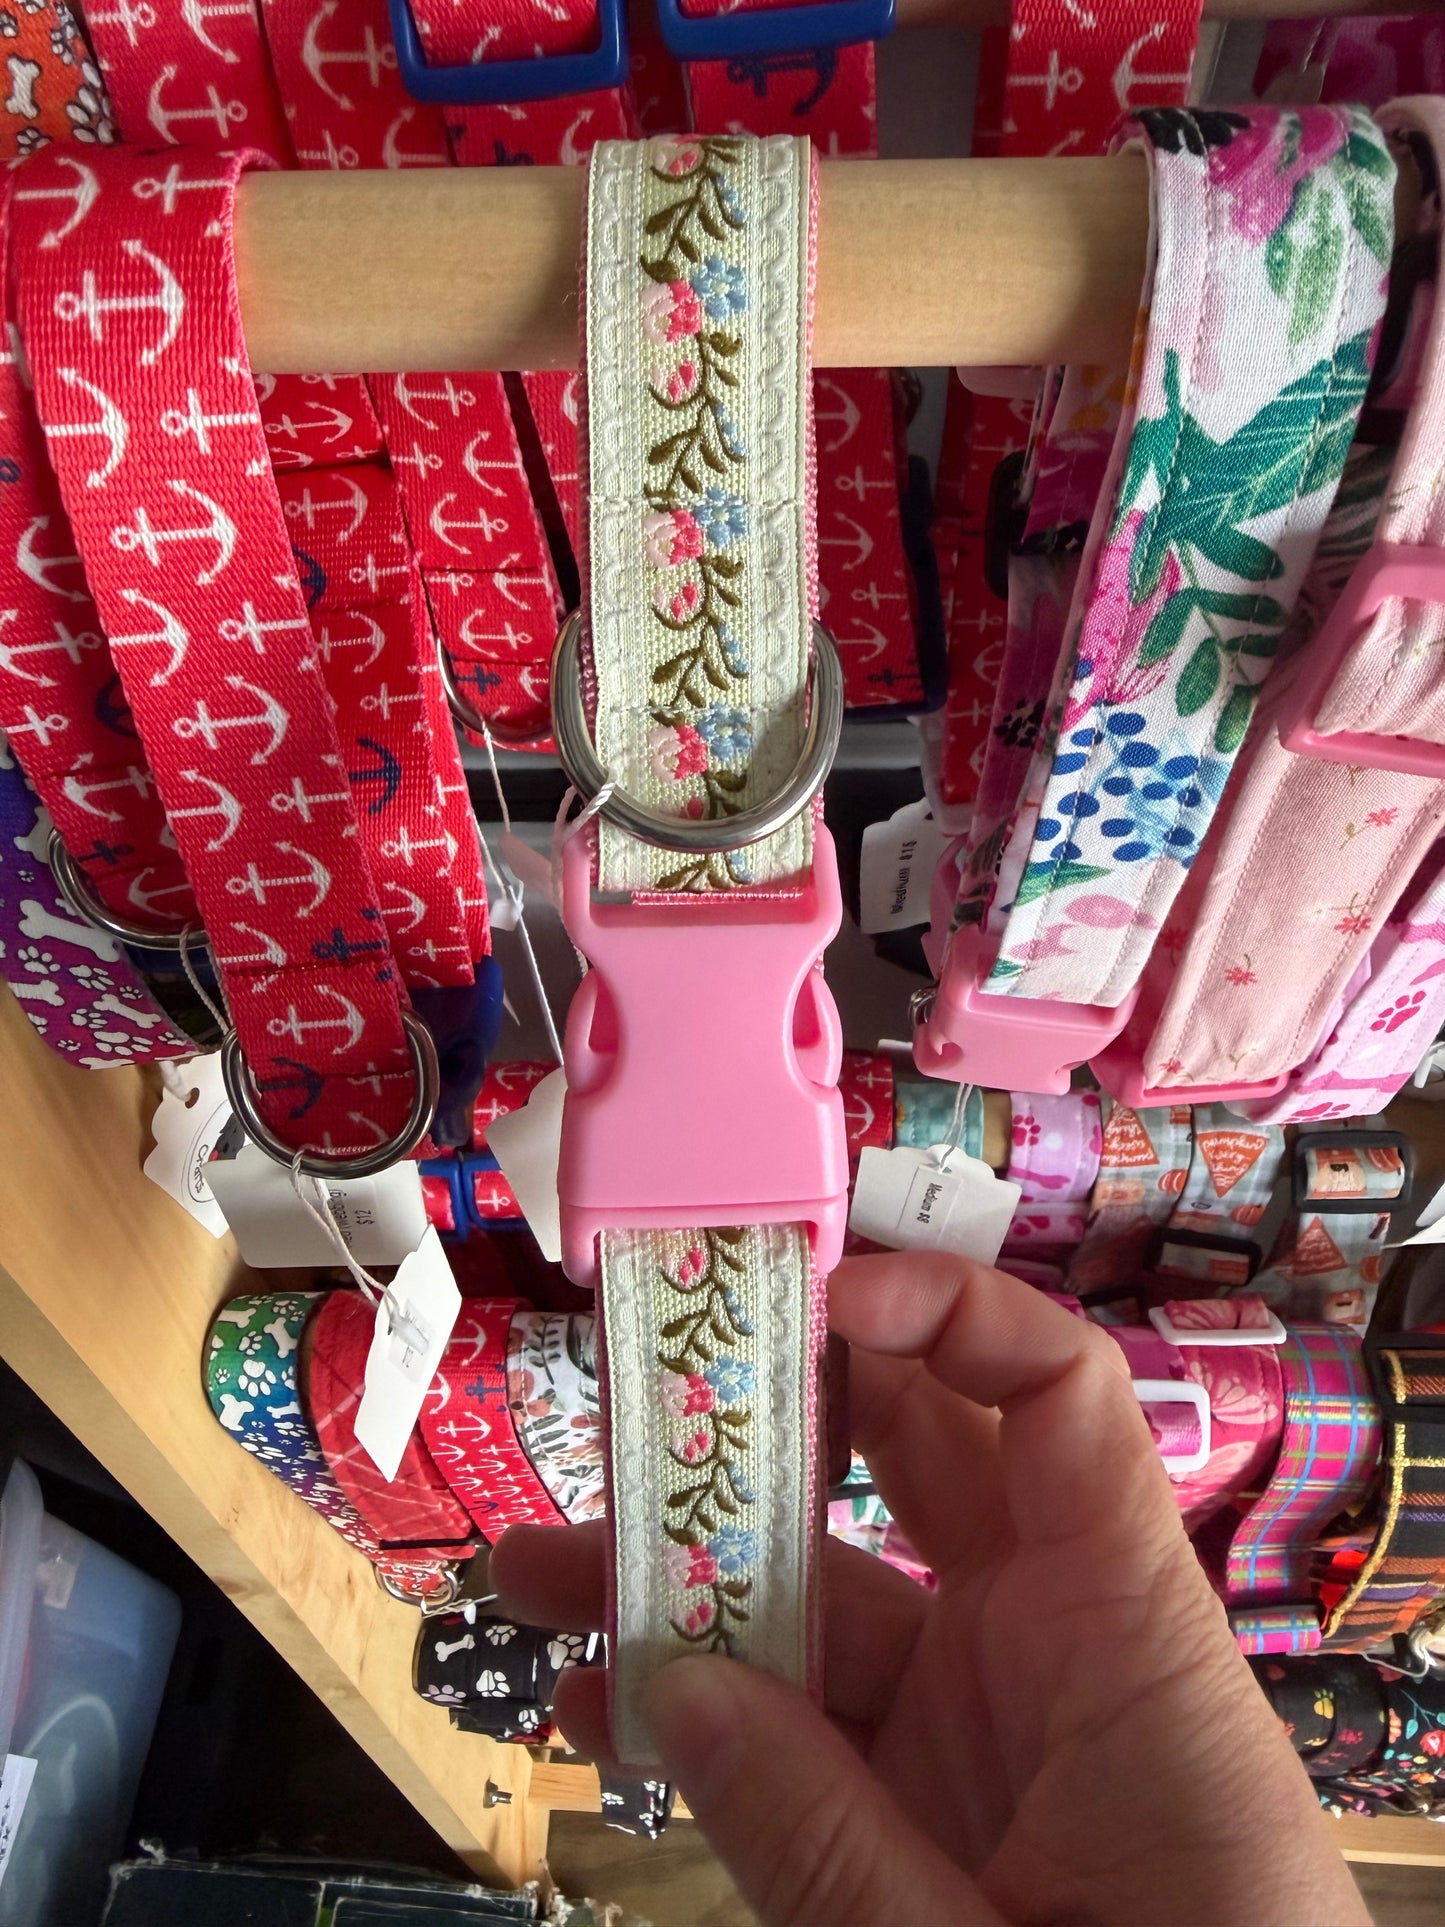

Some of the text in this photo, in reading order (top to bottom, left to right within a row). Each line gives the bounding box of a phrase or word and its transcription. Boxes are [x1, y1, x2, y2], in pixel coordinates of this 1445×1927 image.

[890, 867, 910, 914] Medium
[921, 1183, 943, 1211] Medium
[354, 1209, 375, 1225] $12
